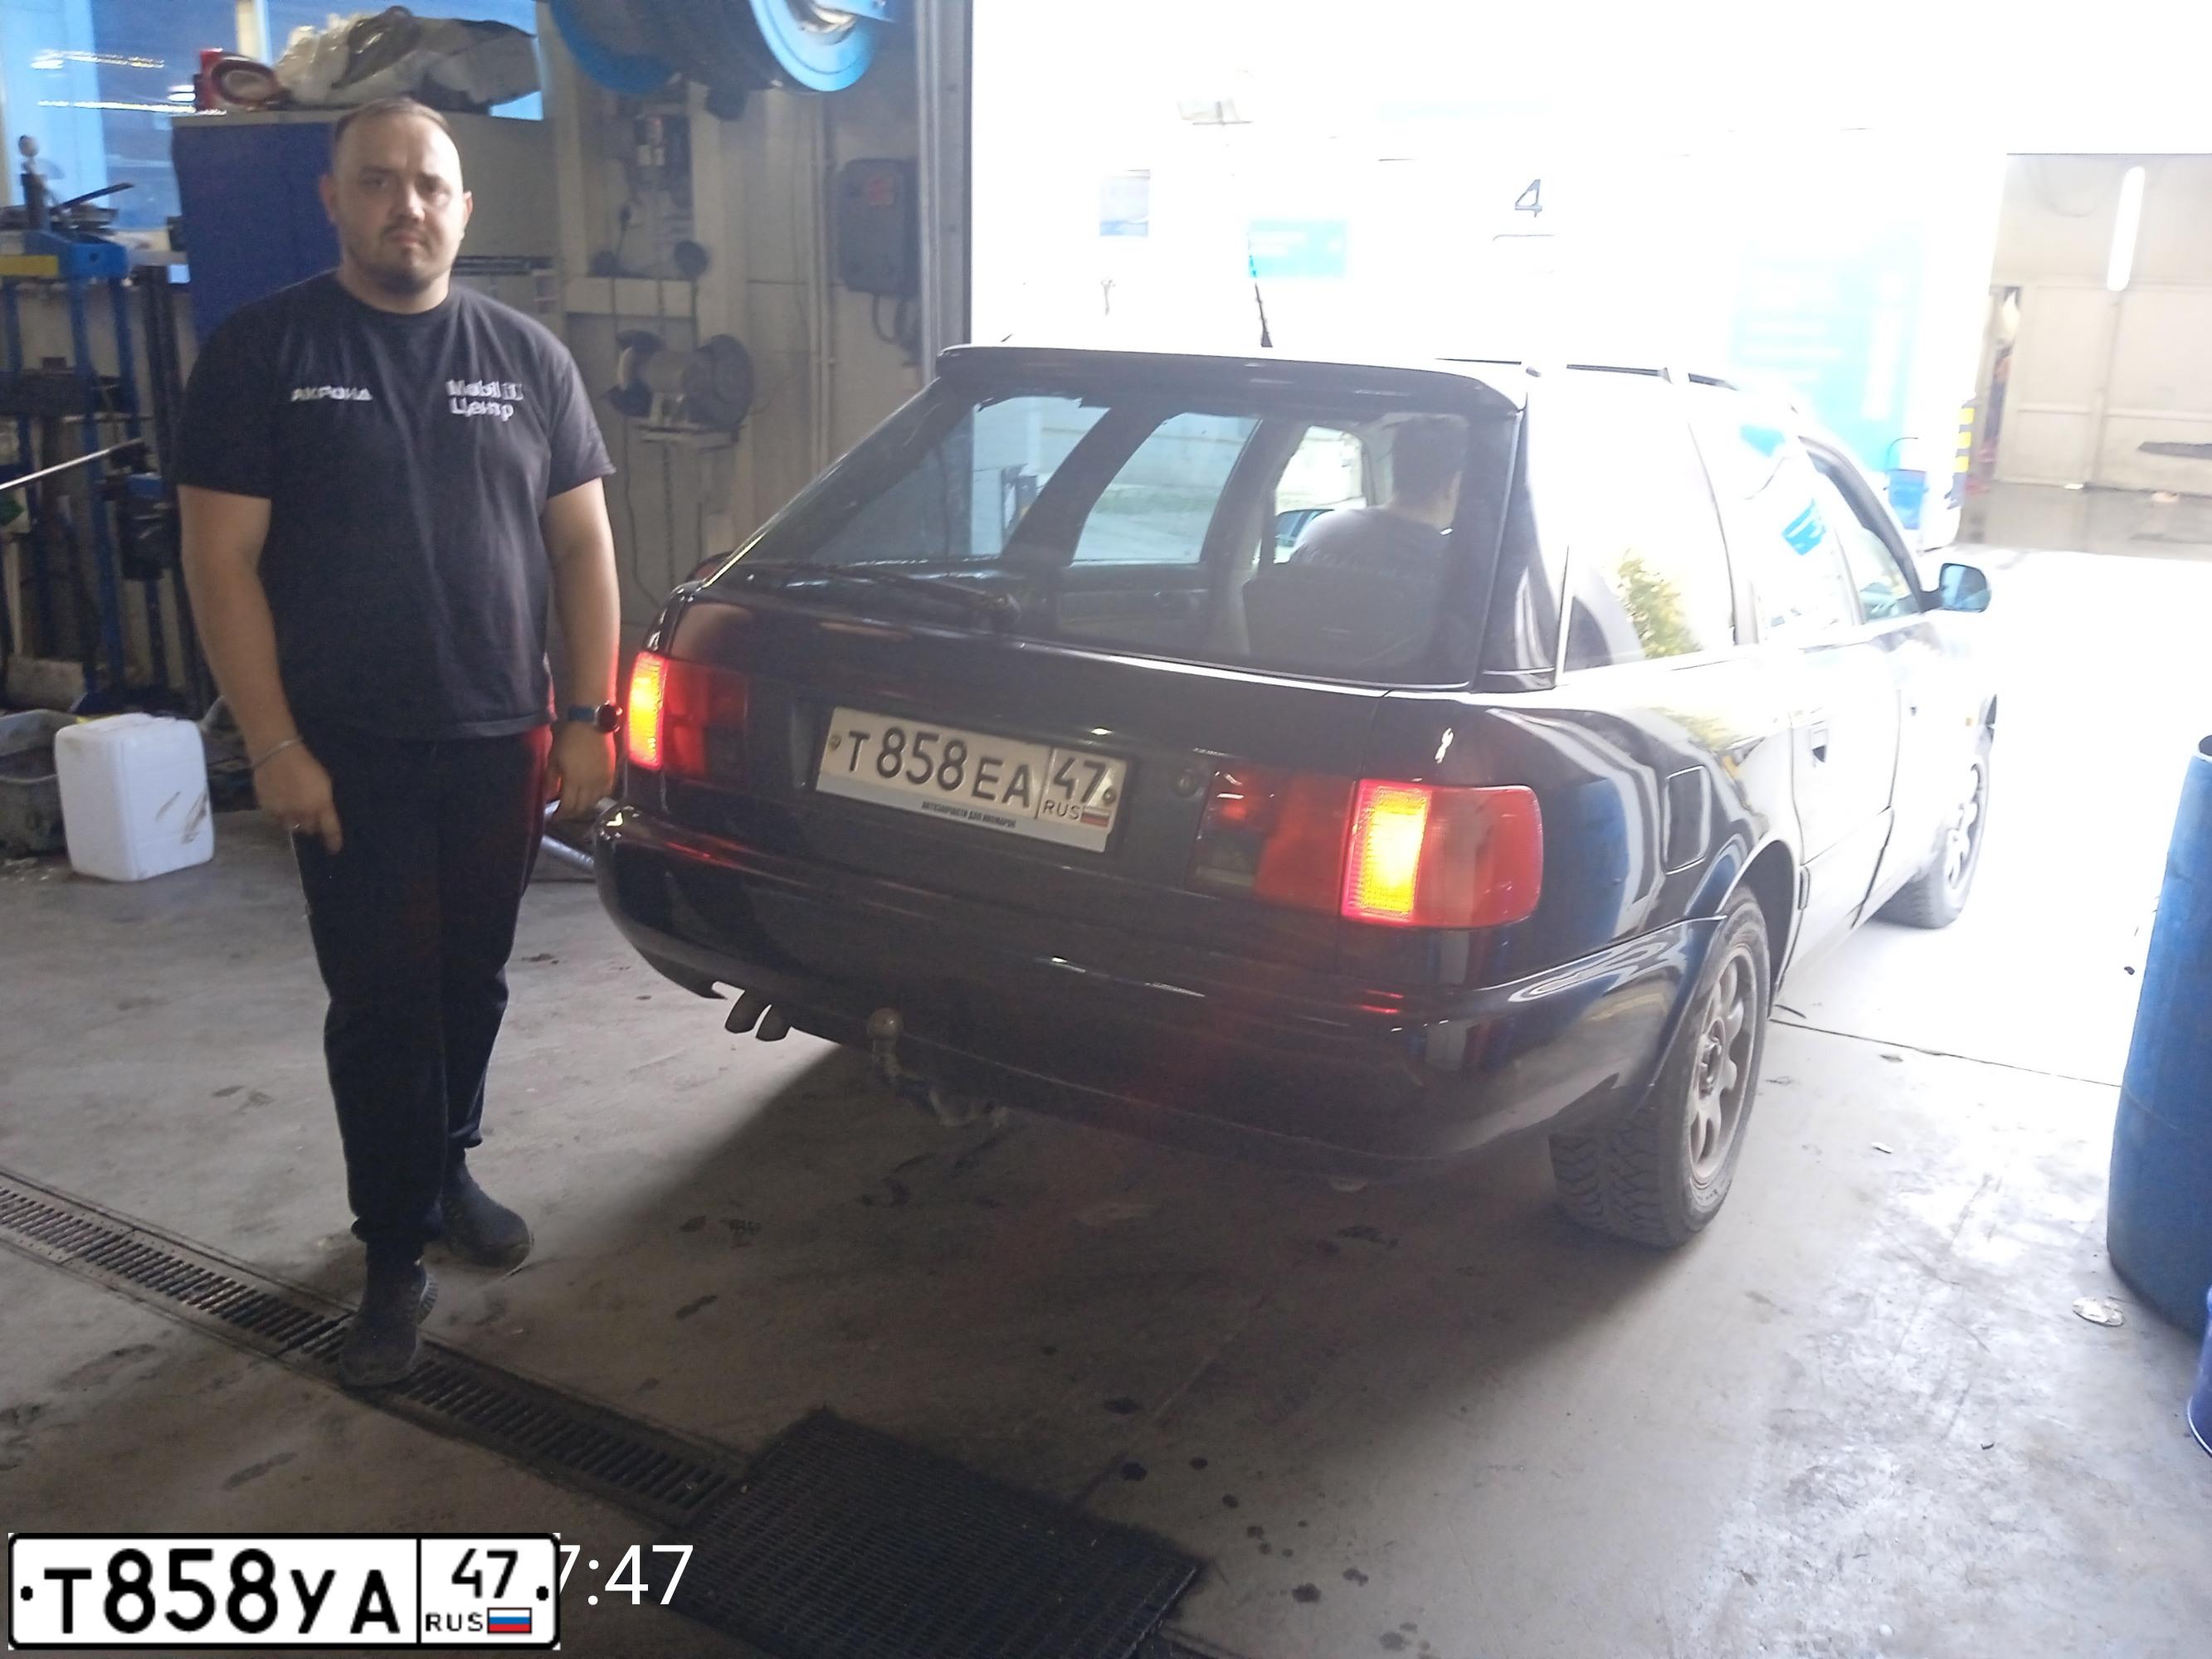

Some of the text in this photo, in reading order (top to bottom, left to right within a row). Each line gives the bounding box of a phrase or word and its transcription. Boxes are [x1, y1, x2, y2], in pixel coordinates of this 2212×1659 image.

[1514, 178, 1542, 217] 4
[1053, 756, 1107, 804] 47
[1043, 800, 1080, 820] RUS
